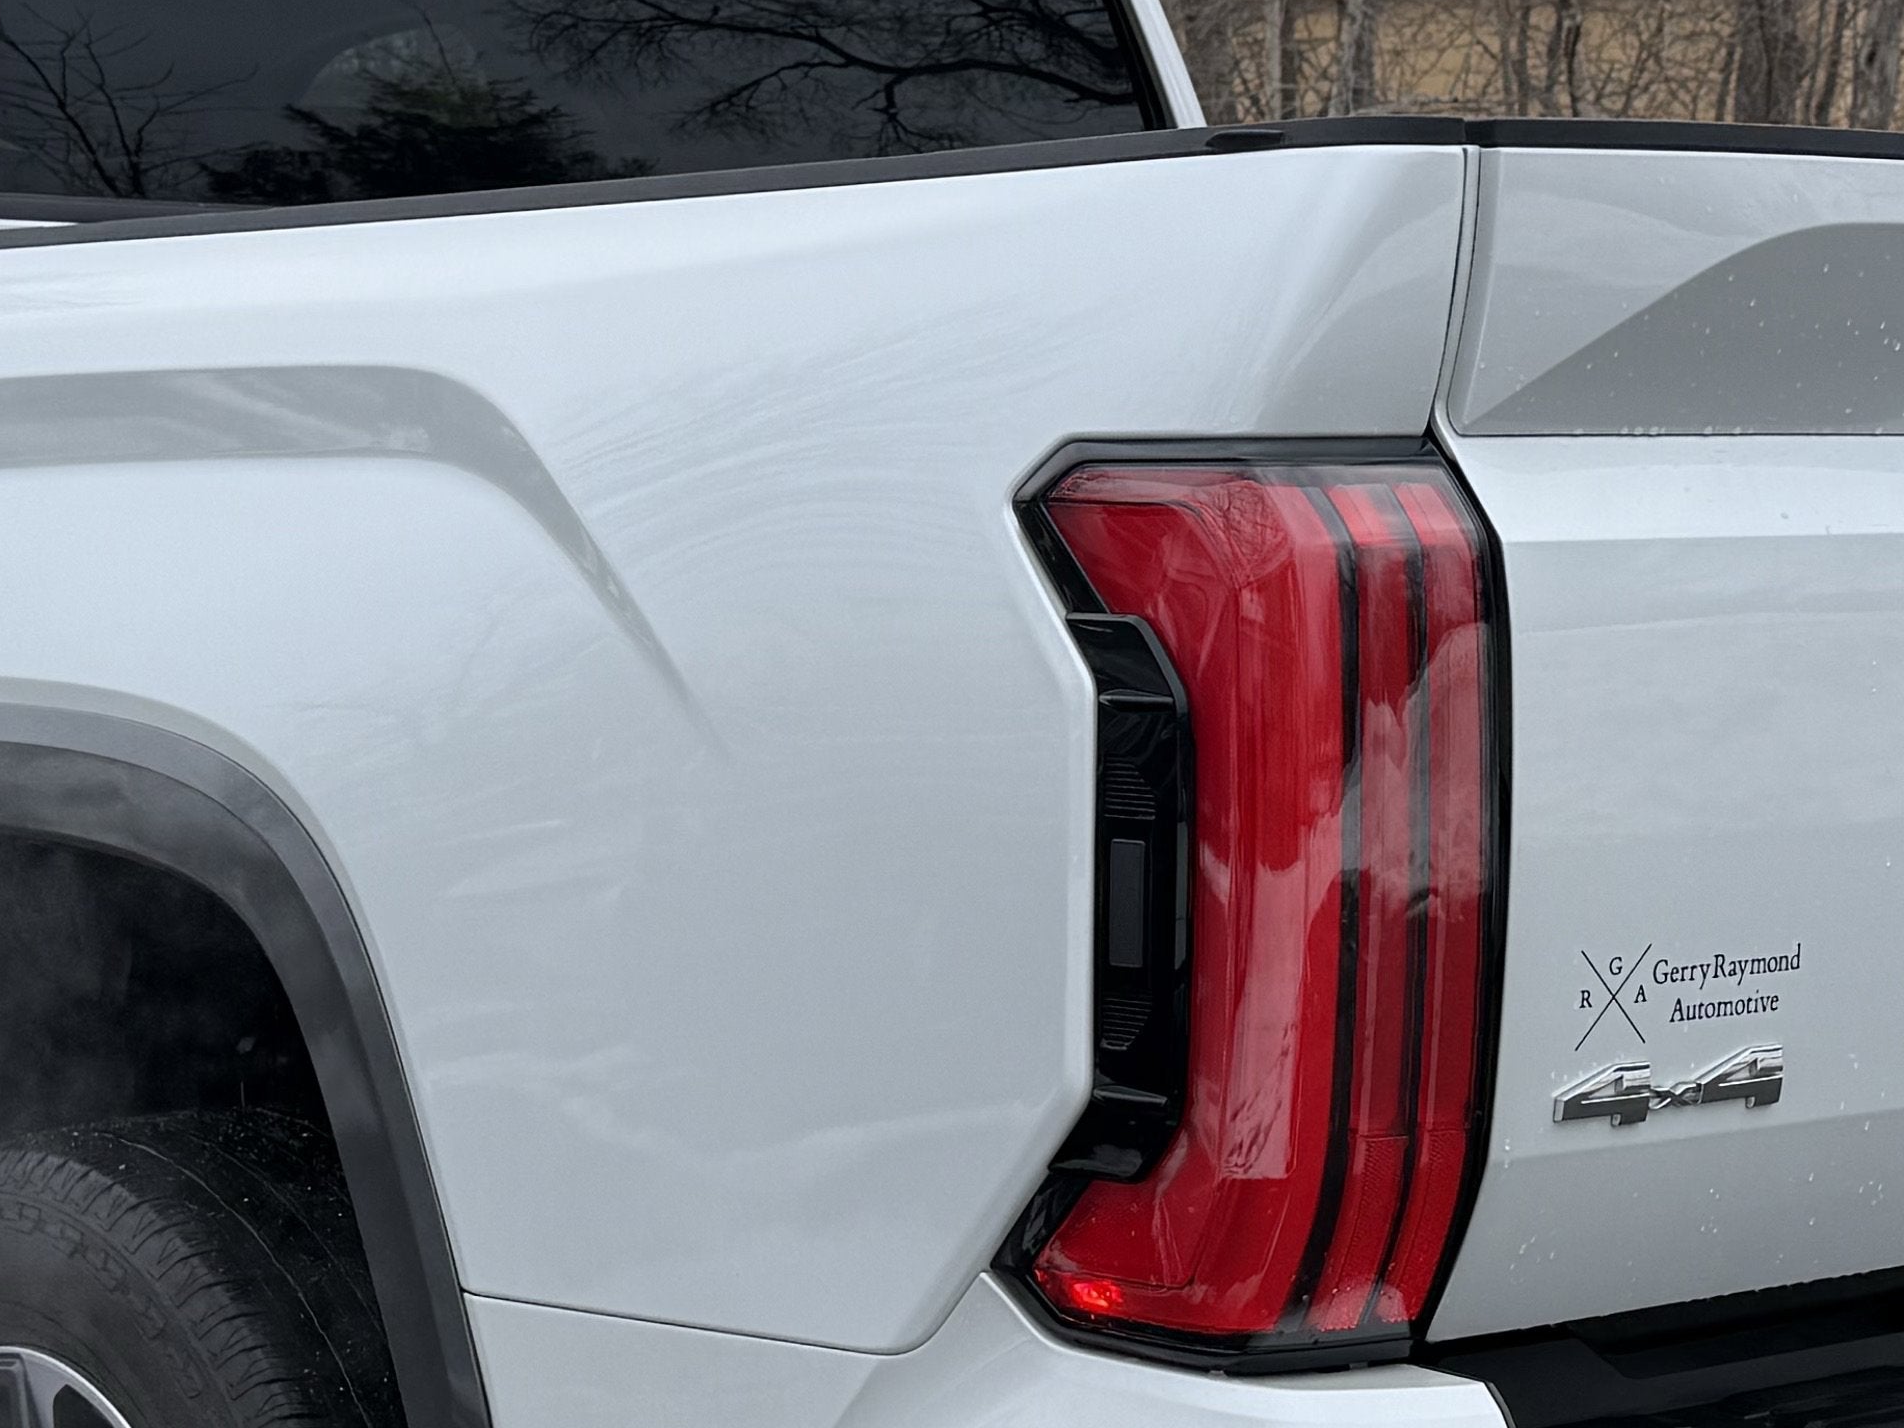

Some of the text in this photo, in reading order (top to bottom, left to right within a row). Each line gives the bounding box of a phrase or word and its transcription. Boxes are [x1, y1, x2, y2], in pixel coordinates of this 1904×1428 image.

[1608, 956, 1624, 976] G
[1652, 943, 1801, 990] Gerry Raymond
[1578, 989, 1593, 1009] R
[1633, 984, 1647, 1004] A
[1668, 988, 1779, 1024] Automotive
[1552, 1043, 1784, 1127] 4x4
